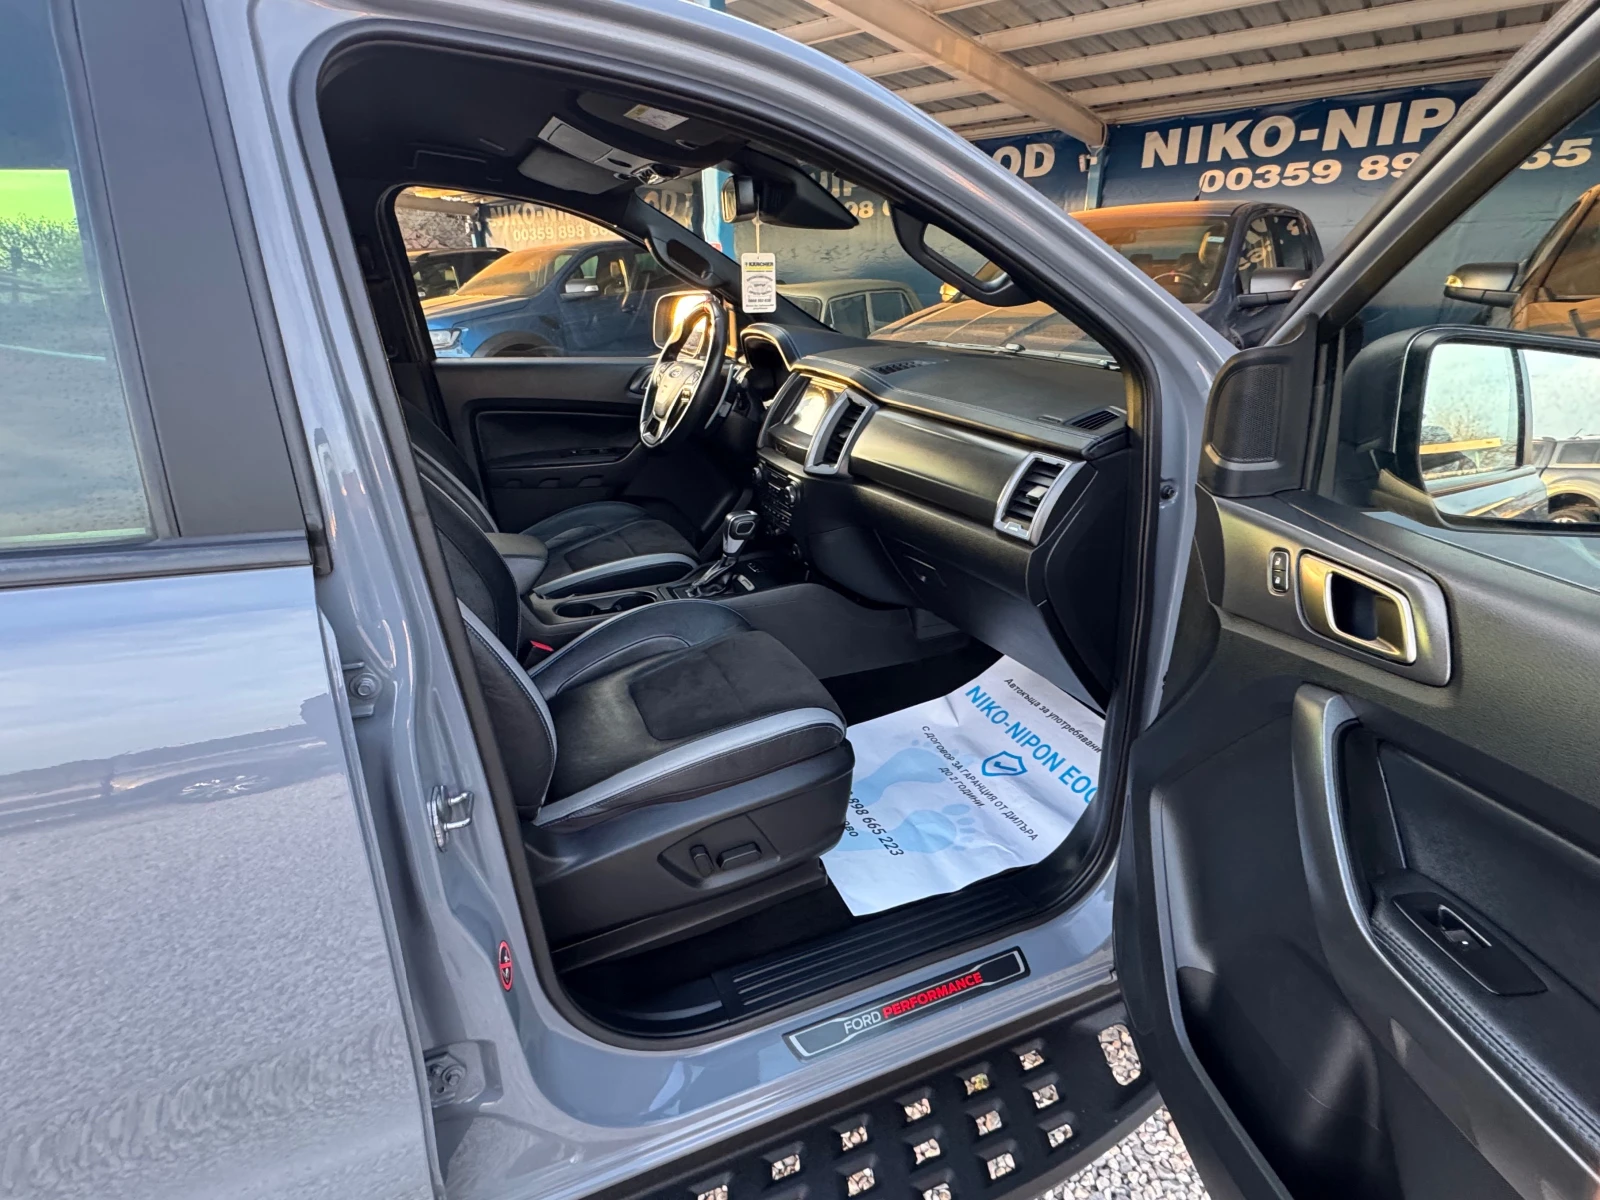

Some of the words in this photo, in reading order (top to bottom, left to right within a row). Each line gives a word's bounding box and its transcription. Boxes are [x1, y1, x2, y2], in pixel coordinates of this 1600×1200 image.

[1199, 158, 1342, 193] 00359
[513, 227, 554, 242] 00359
[558, 224, 585, 239] 898
[1004, 678, 1041, 707] Автокъща
[1039, 704, 1050, 714] за
[965, 685, 1066, 773] NIKO-NIPON
[924, 732, 955, 762] ДОГОВОР
[951, 760, 964, 770] ЗА
[960, 768, 998, 802] ГАРАНЦИЯ
[994, 801, 1008, 811] ОТ
[1002, 810, 1038, 841] ДИЛЪРА
[938, 766, 953, 777] ДО
[862, 817, 887, 835] 665
[878, 836, 904, 856] 223
[844, 1011, 881, 1034] FORD
[882, 971, 983, 1019] PERFORMANCE
